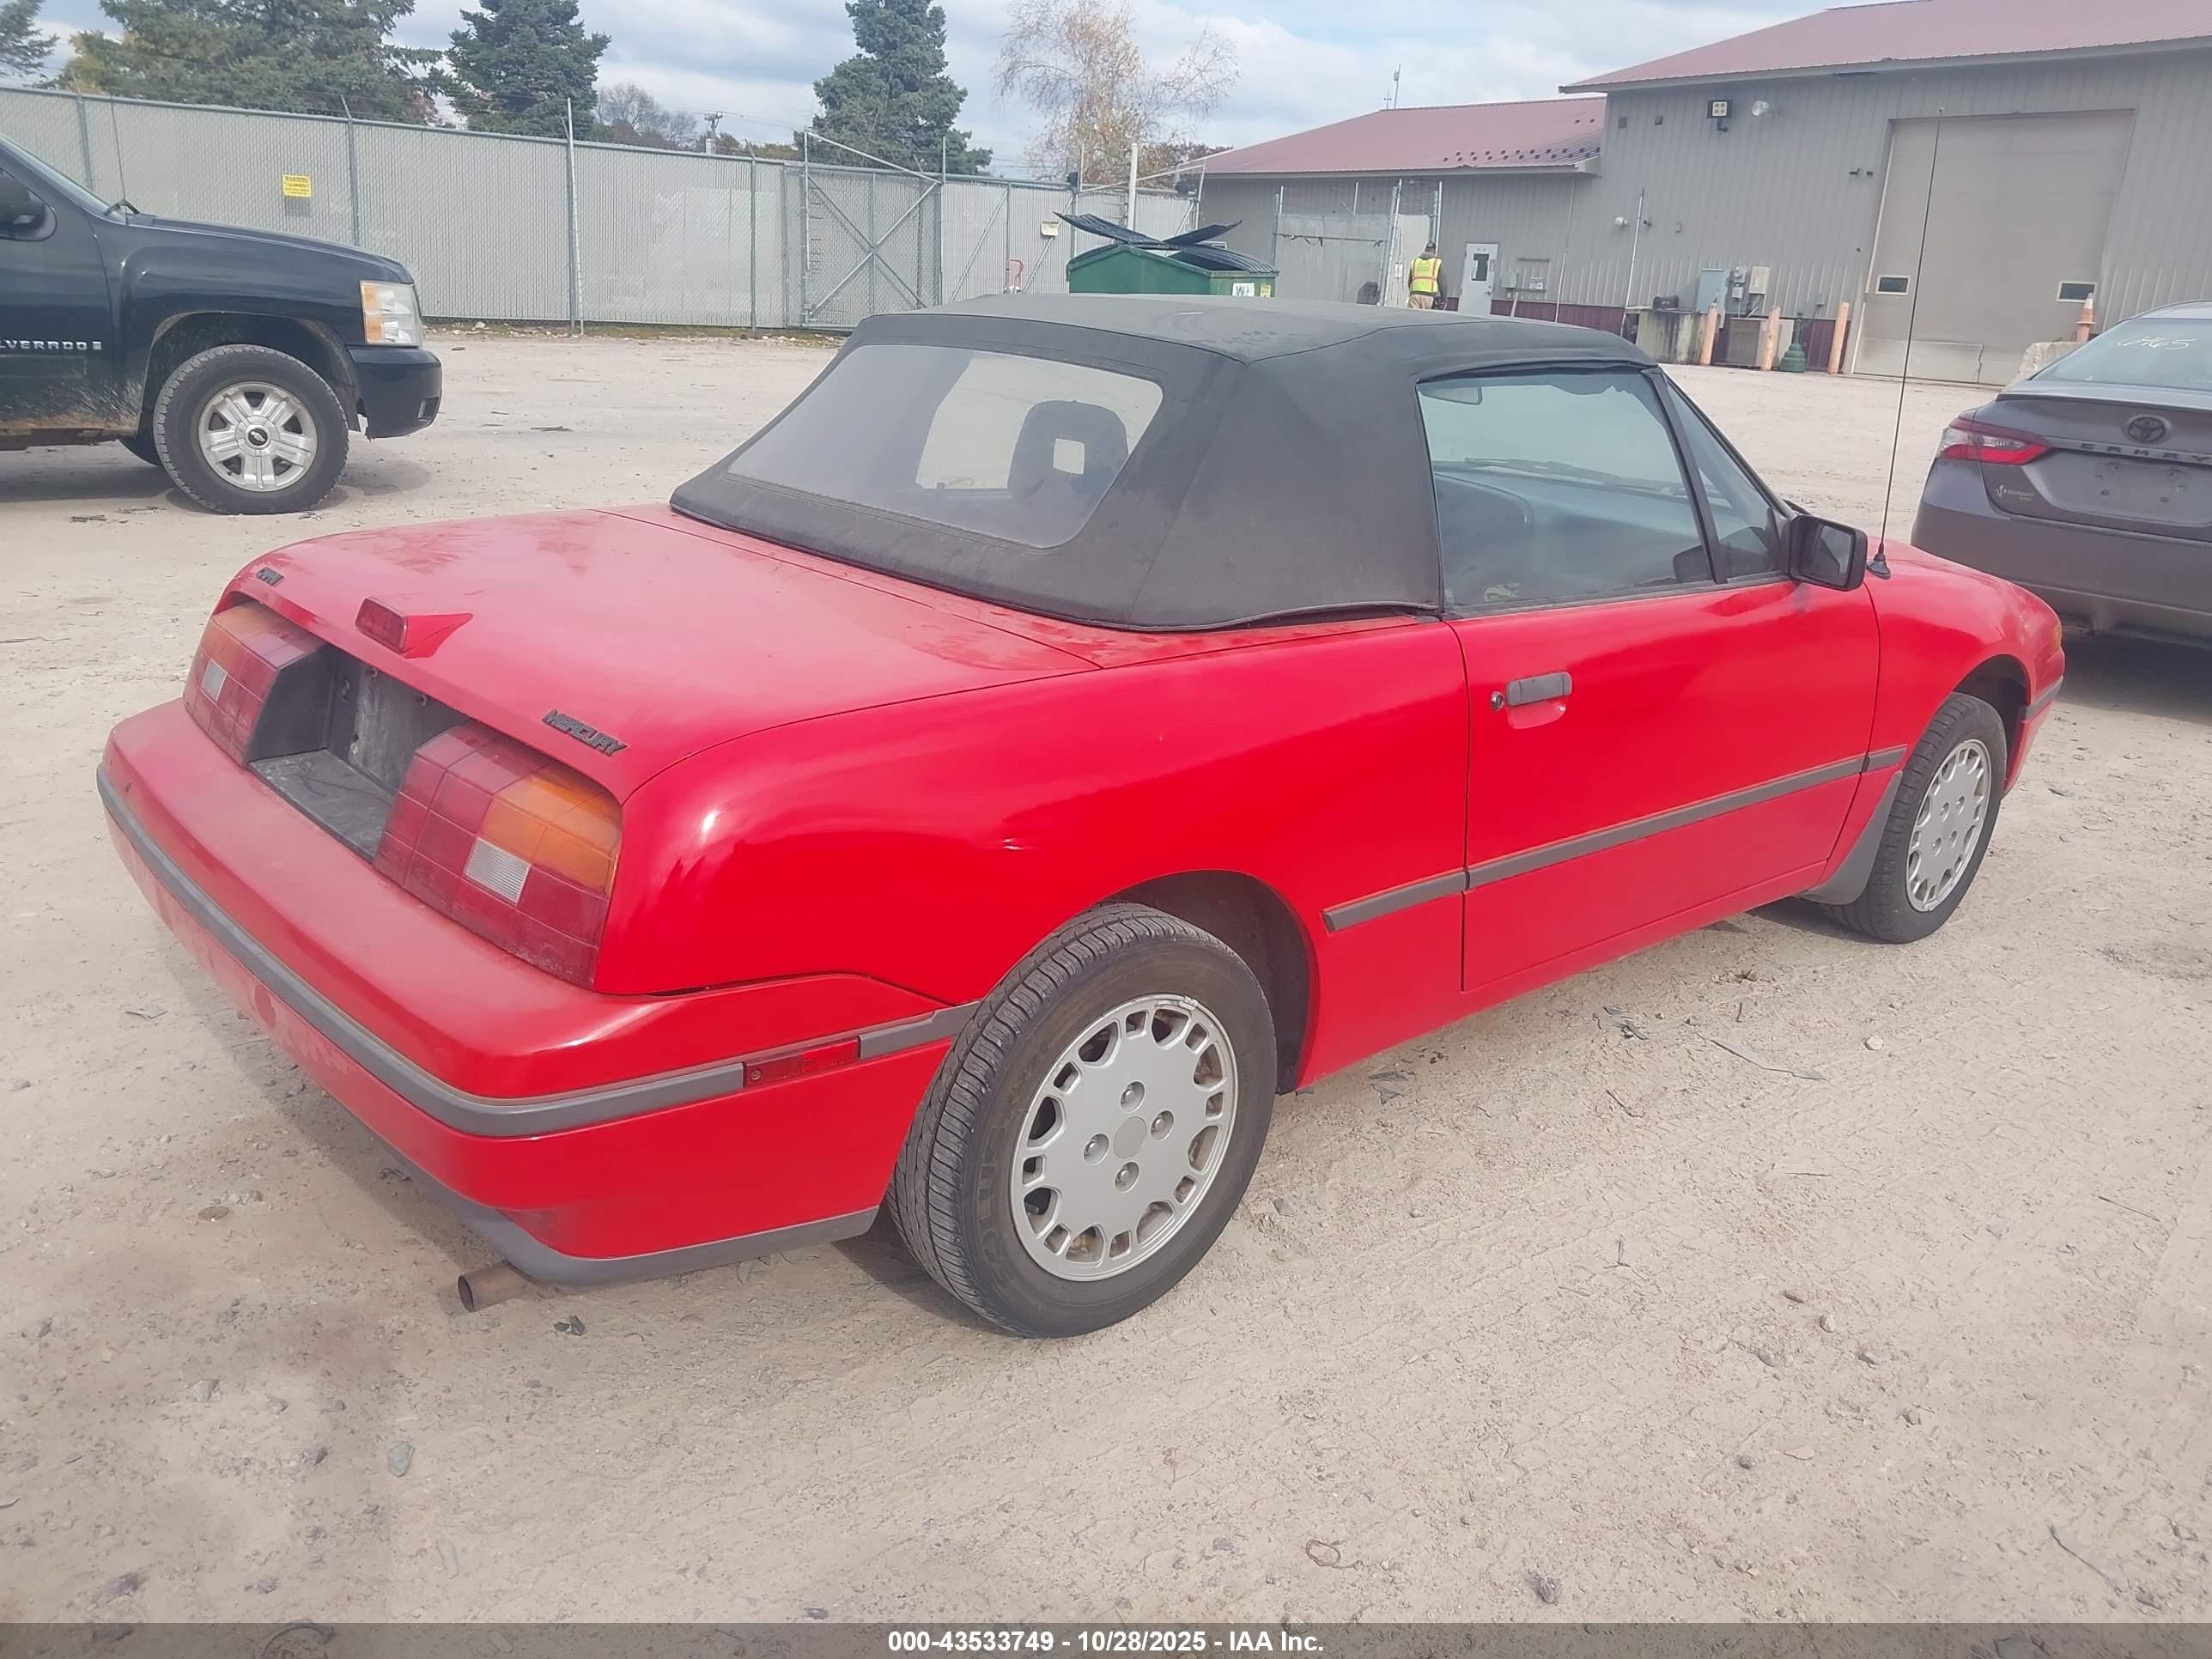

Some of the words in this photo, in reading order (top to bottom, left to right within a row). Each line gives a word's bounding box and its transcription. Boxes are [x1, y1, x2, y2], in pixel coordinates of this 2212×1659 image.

[0, 339, 88, 350] LVERADO
[2081, 442, 2210, 462] CAMRY
[541, 709, 628, 757] MERCURY
